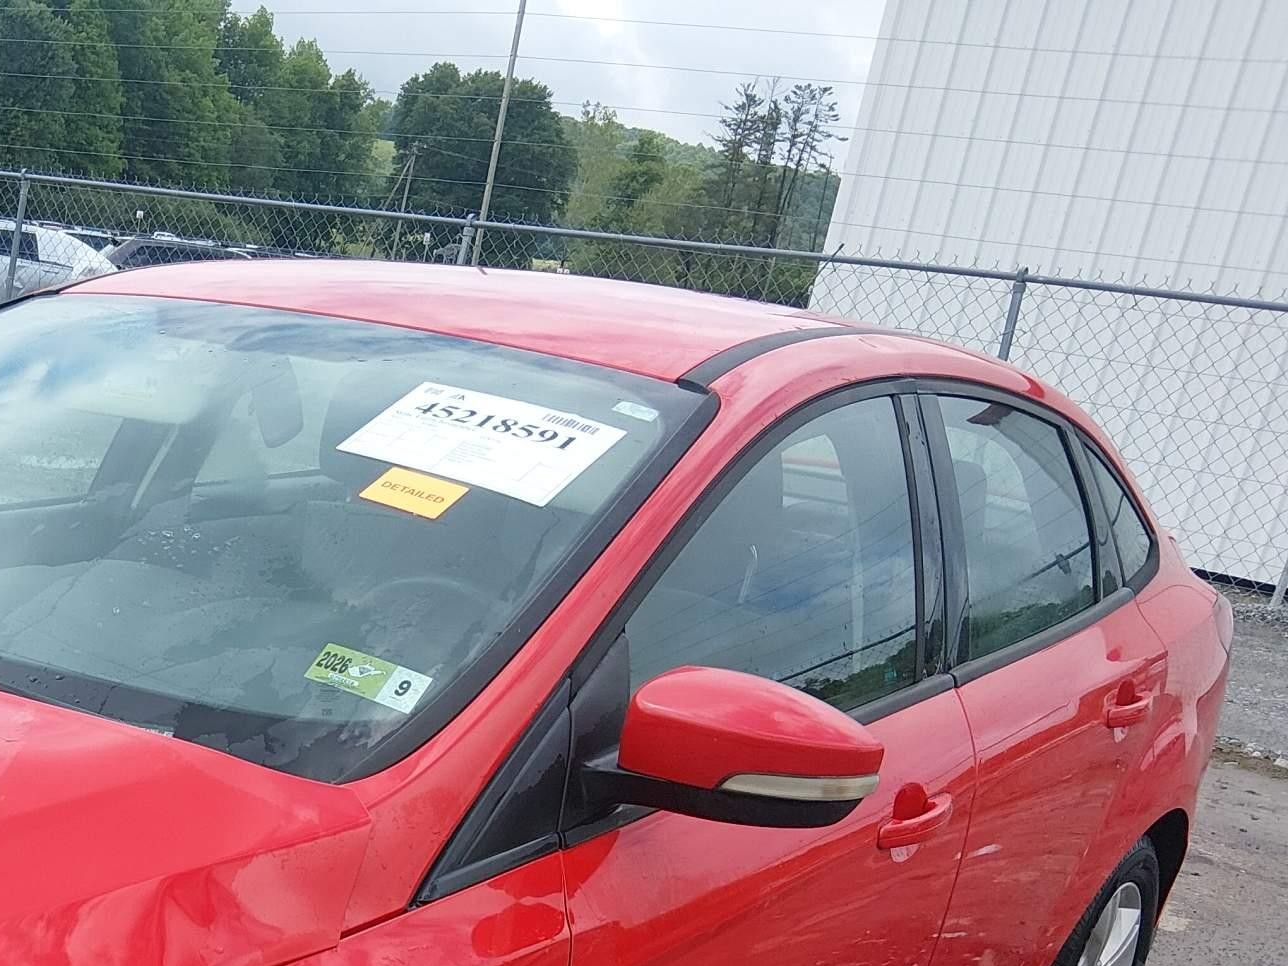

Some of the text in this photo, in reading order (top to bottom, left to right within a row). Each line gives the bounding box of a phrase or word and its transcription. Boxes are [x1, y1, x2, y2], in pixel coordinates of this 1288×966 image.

[414, 402, 577, 450] 45218591
[381, 481, 445, 503] DETAILED
[315, 651, 352, 674] 2026
[394, 680, 412, 697] 9
